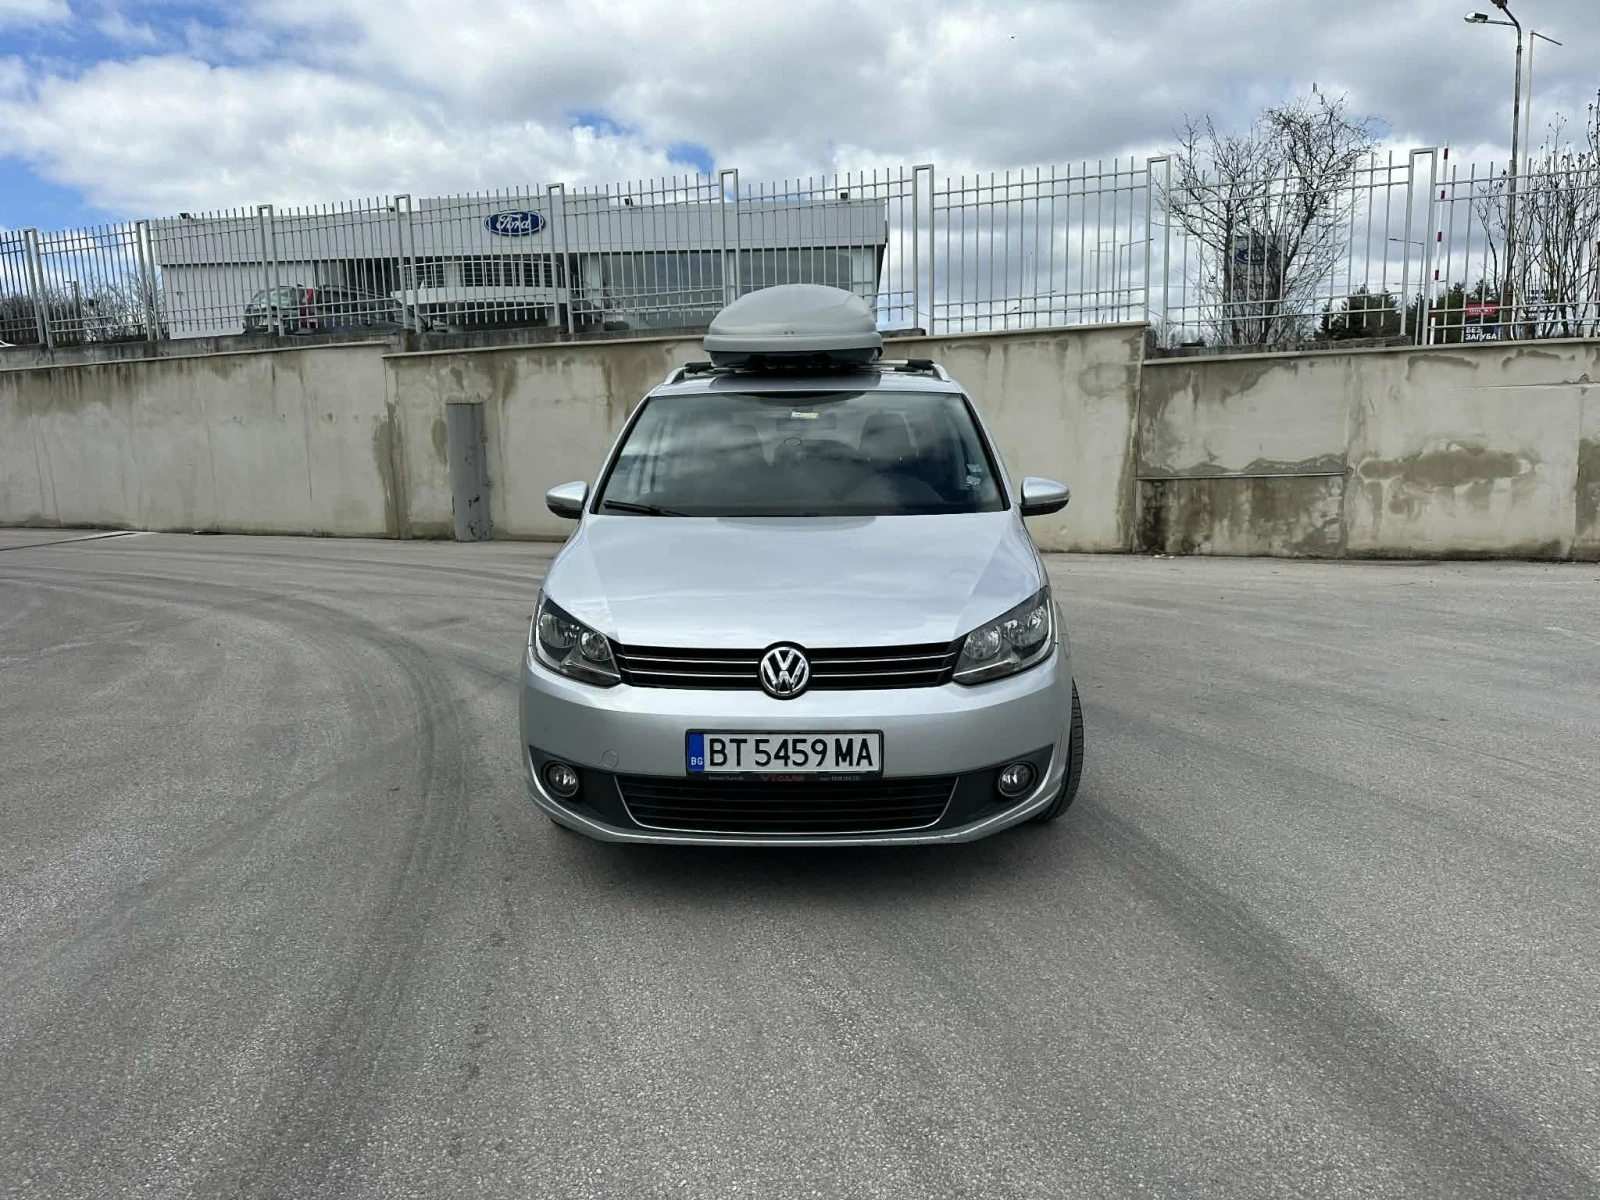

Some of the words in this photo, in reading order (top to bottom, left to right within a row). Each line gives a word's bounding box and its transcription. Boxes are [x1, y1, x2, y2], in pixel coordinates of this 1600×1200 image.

[496, 214, 531, 229] Ford
[1465, 333, 1498, 341] ЗАГУБА
[760, 646, 809, 694] VW
[709, 738, 748, 767] BT
[754, 738, 828, 767] 5459
[834, 738, 874, 767] MA
[690, 756, 704, 766] BG
